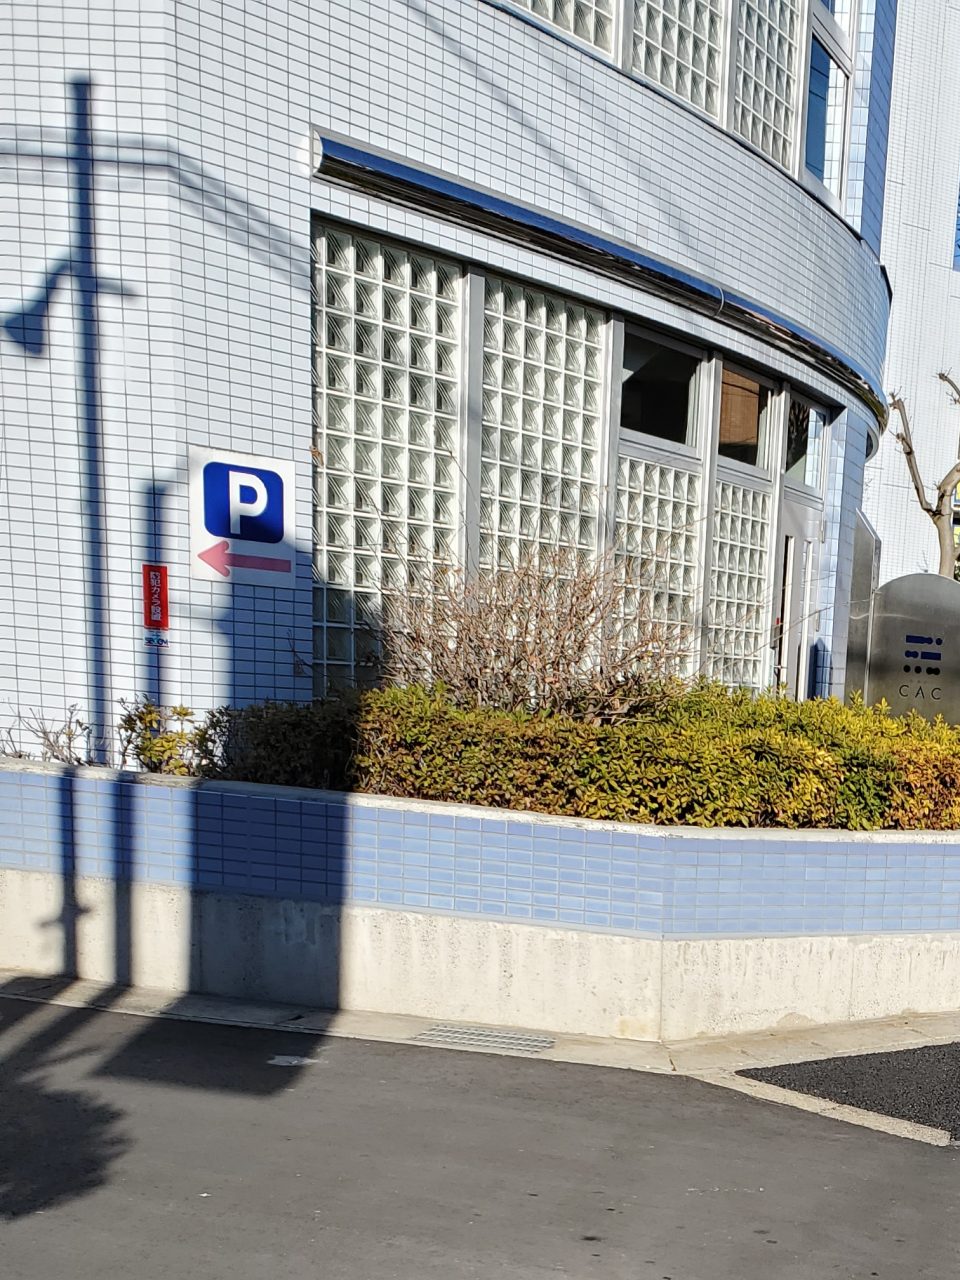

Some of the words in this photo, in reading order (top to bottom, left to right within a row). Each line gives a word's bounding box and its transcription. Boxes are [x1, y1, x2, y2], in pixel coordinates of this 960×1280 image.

[228, 470, 268, 535] P
[149, 571, 161, 621] 防犯カメラ設置
[898, 684, 942, 700] CAC
